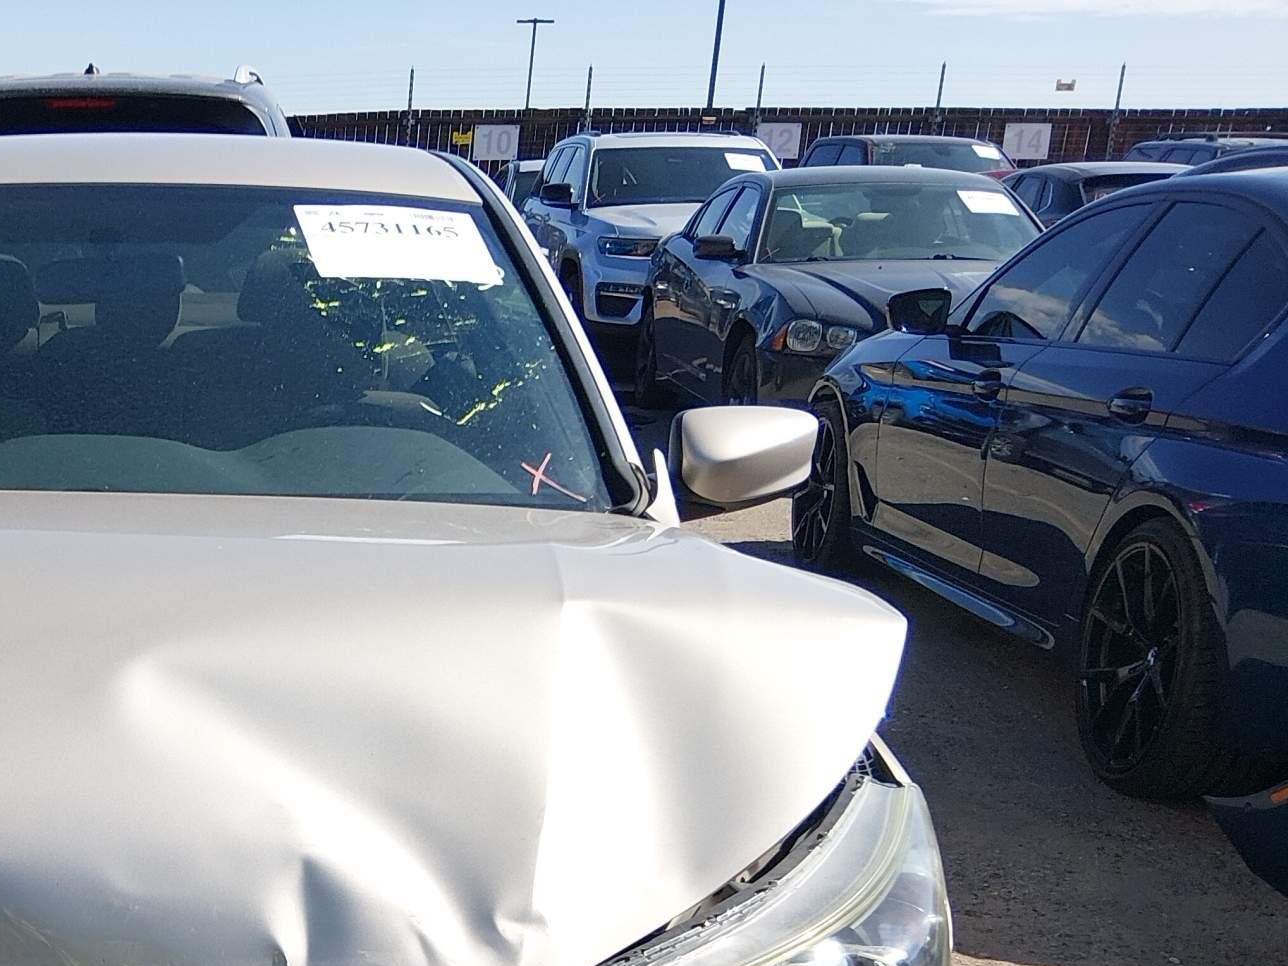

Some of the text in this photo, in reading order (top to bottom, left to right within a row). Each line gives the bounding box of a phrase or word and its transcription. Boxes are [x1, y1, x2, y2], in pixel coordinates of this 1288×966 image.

[481, 129, 513, 155] 10
[763, 127, 793, 153] 12
[1013, 127, 1043, 154] 14
[320, 220, 460, 239] 45731165
